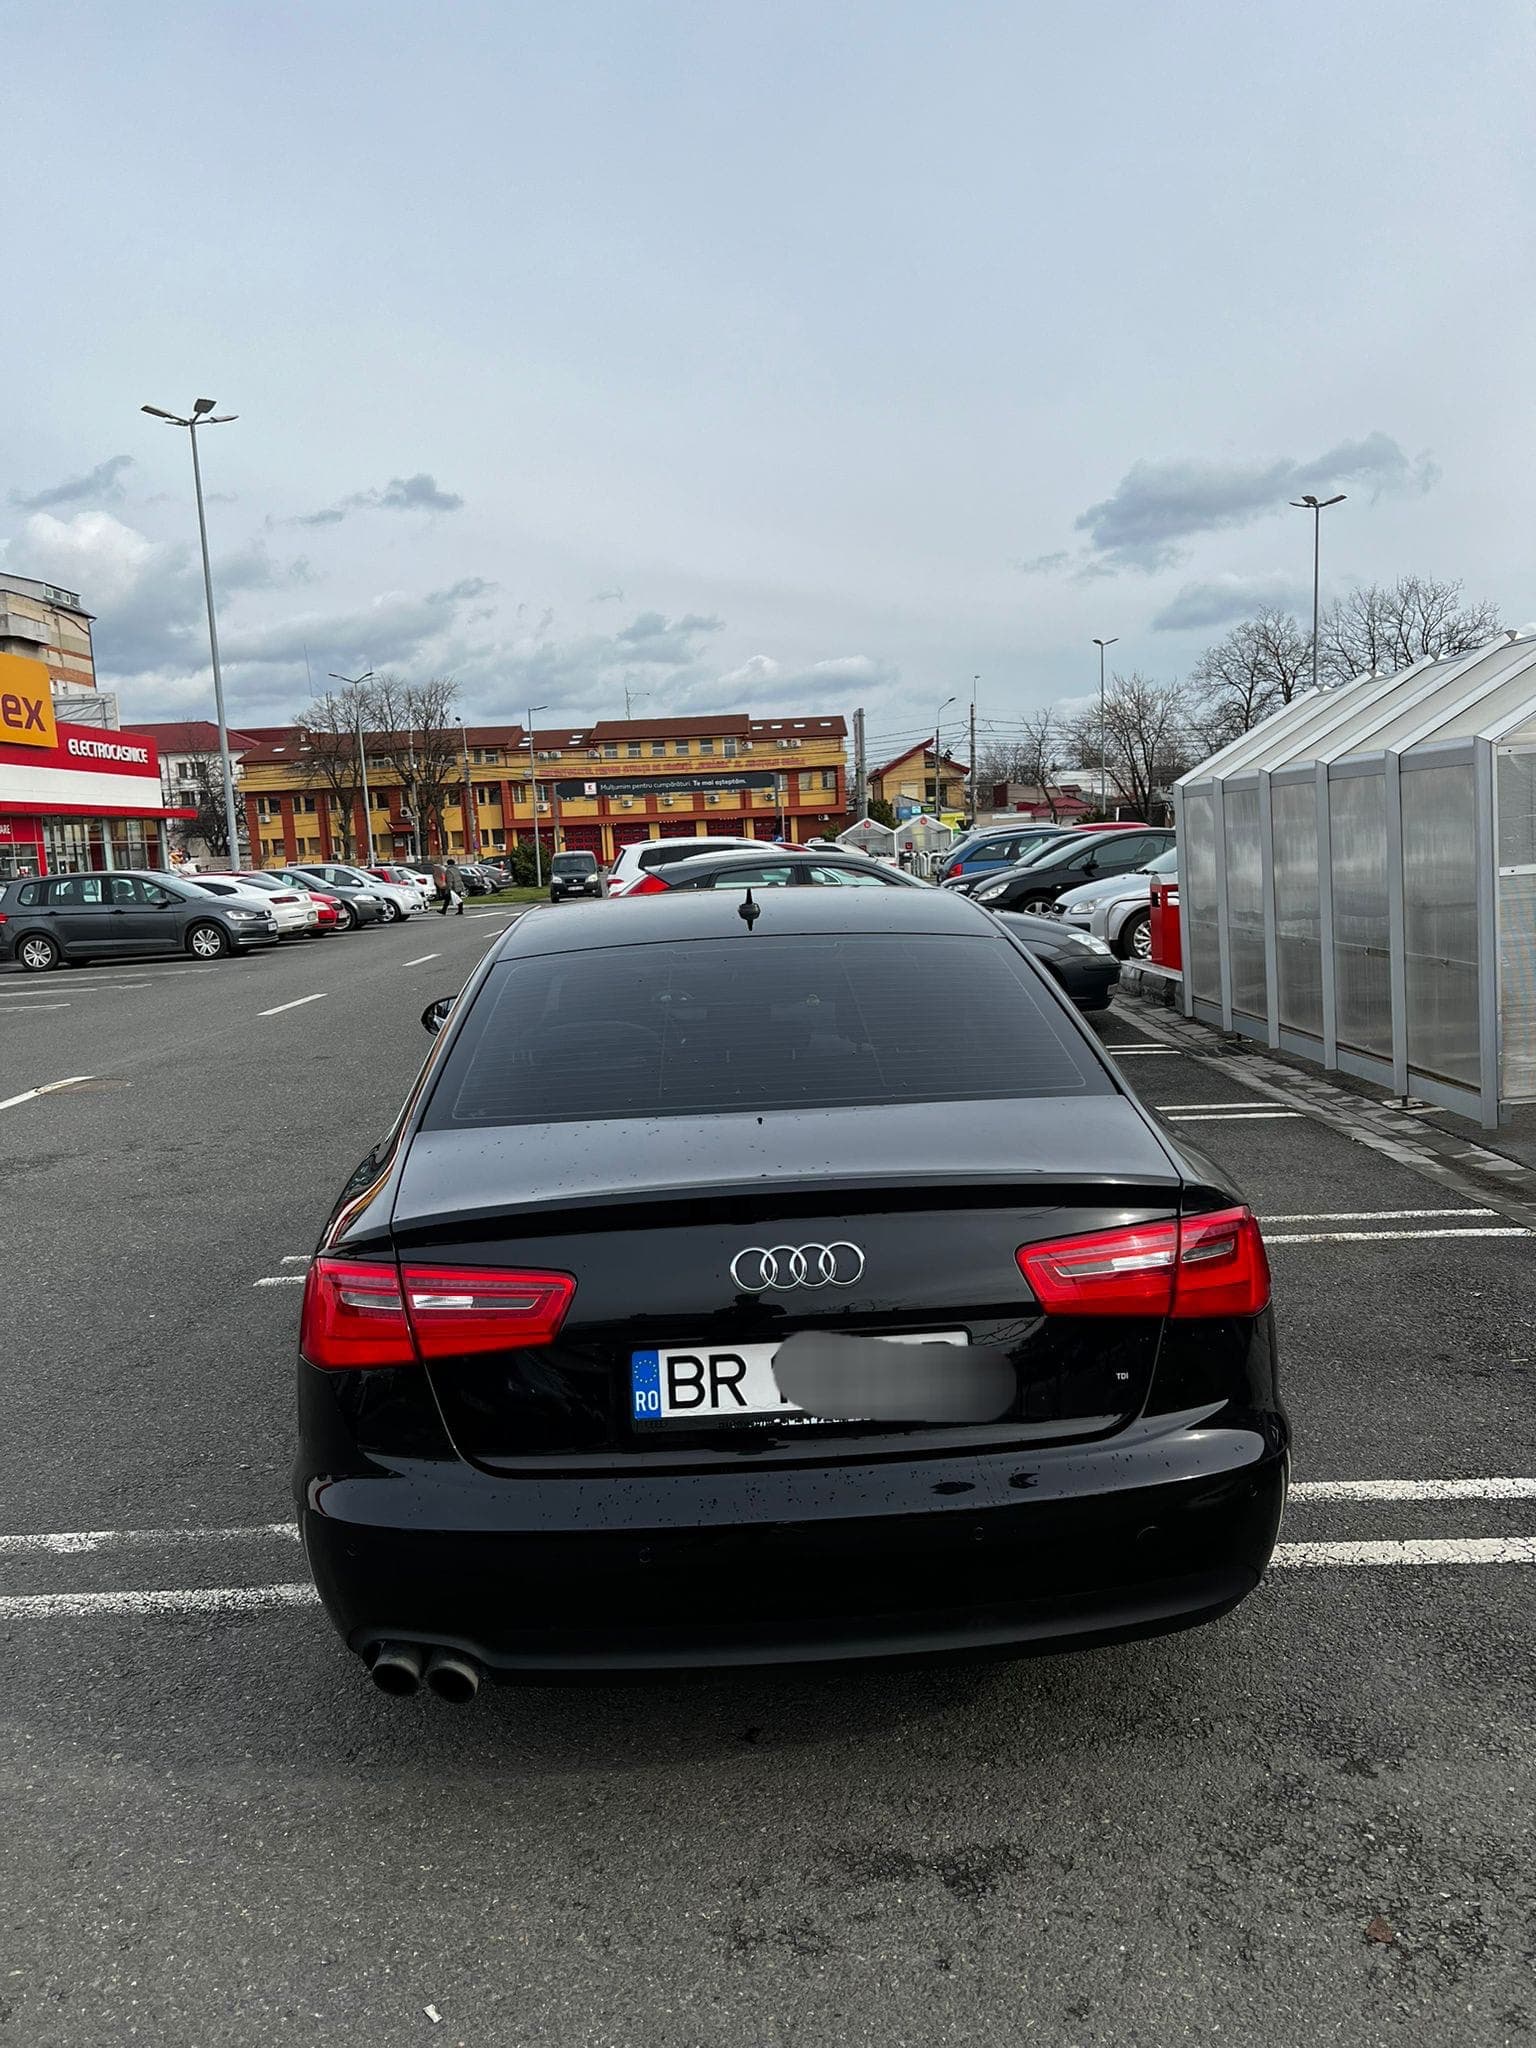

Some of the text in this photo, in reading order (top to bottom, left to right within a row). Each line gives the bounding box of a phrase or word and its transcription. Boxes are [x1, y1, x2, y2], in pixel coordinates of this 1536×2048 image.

[1, 693, 46, 732] ex
[67, 738, 149, 764] ELECTROCASNICE
[632, 782, 653, 790] pentru
[693, 779, 701, 787] Te
[667, 1353, 748, 1410] BR
[1116, 1371, 1129, 1381] TDI
[635, 1390, 659, 1412] RO
